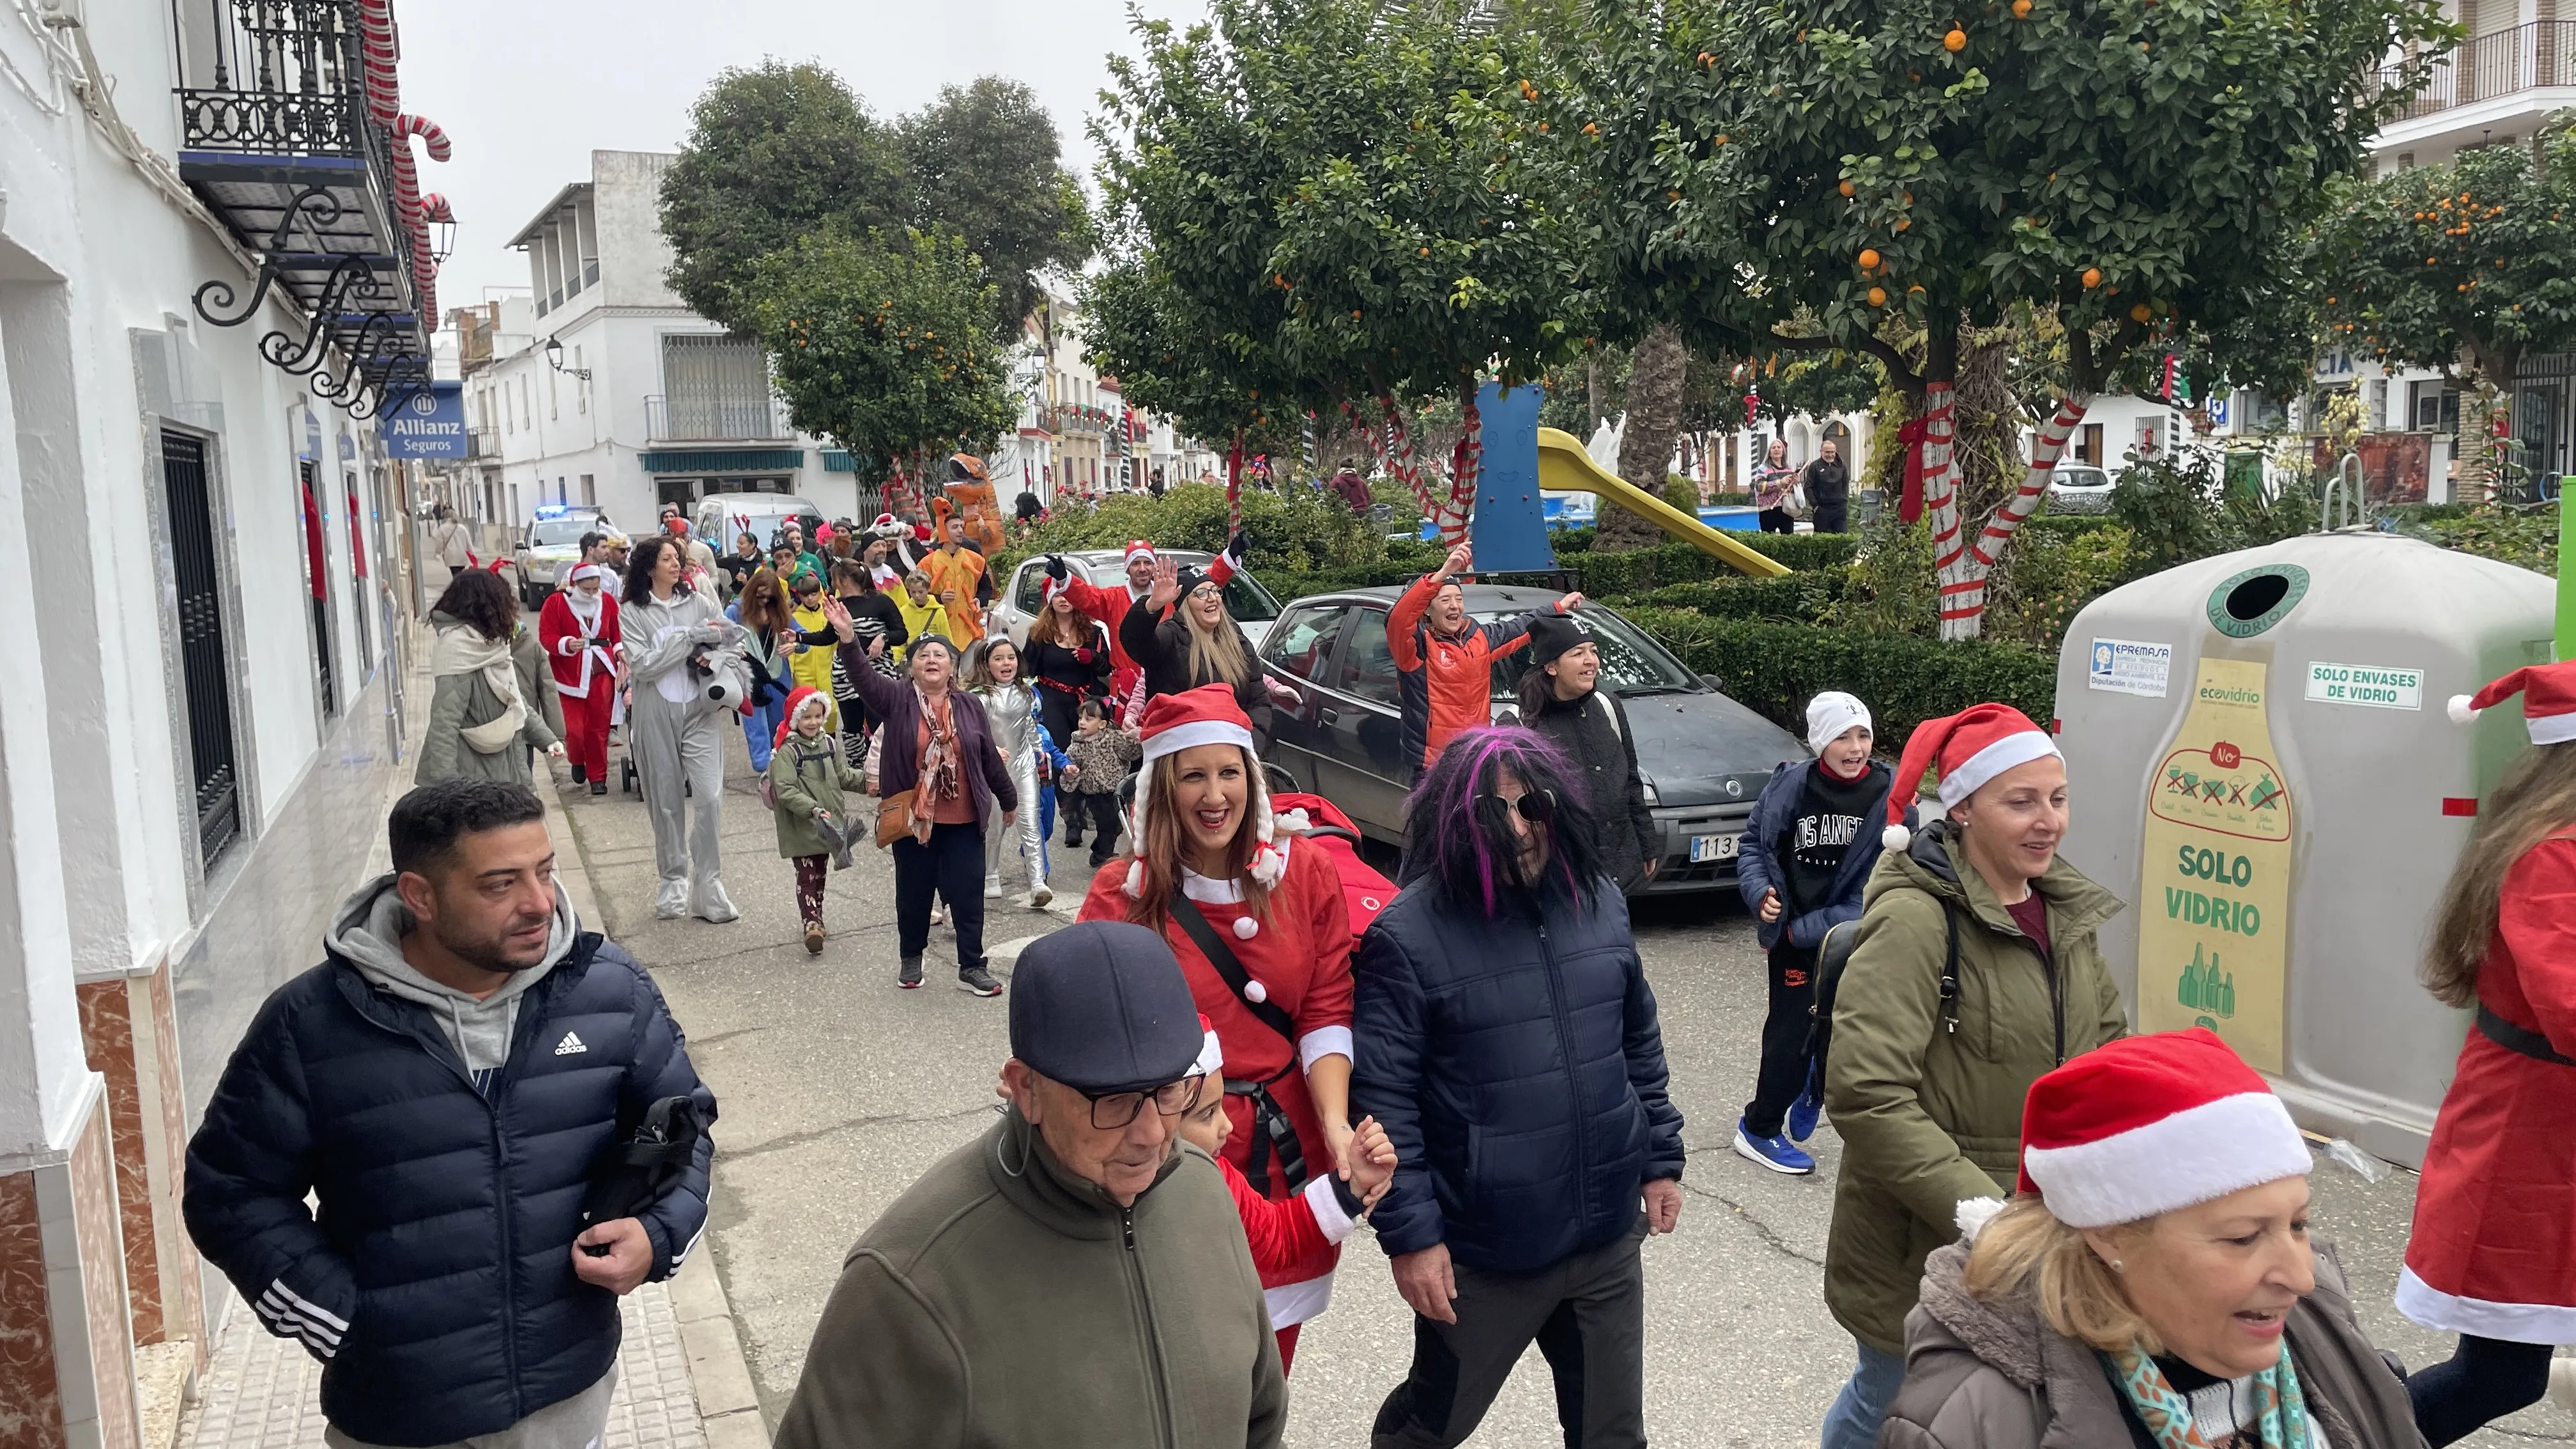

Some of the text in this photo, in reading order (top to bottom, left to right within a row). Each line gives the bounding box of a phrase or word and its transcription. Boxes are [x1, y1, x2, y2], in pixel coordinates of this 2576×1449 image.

[393, 418, 460, 435] Allianz
[404, 439, 451, 454] Seguros
[2218, 565, 2307, 599] SOLO ENVASES
[2211, 607, 2280, 635] DE VIDRIO
[2116, 645, 2168, 659] EPREMASA
[2091, 677, 2126, 687] Diputación
[2137, 681, 2165, 692] Córdoba
[2313, 668, 2416, 687] SOLO ENVASES
[2200, 686, 2259, 703] ecovidrio
[2327, 685, 2397, 702] DE VIDRIO
[2217, 747, 2237, 763] No
[1705, 838, 1740, 857] 113
[2178, 845, 2251, 887] SOLO
[2165, 885, 2260, 937] VIDRIO
[555, 1045, 587, 1055] adidas
